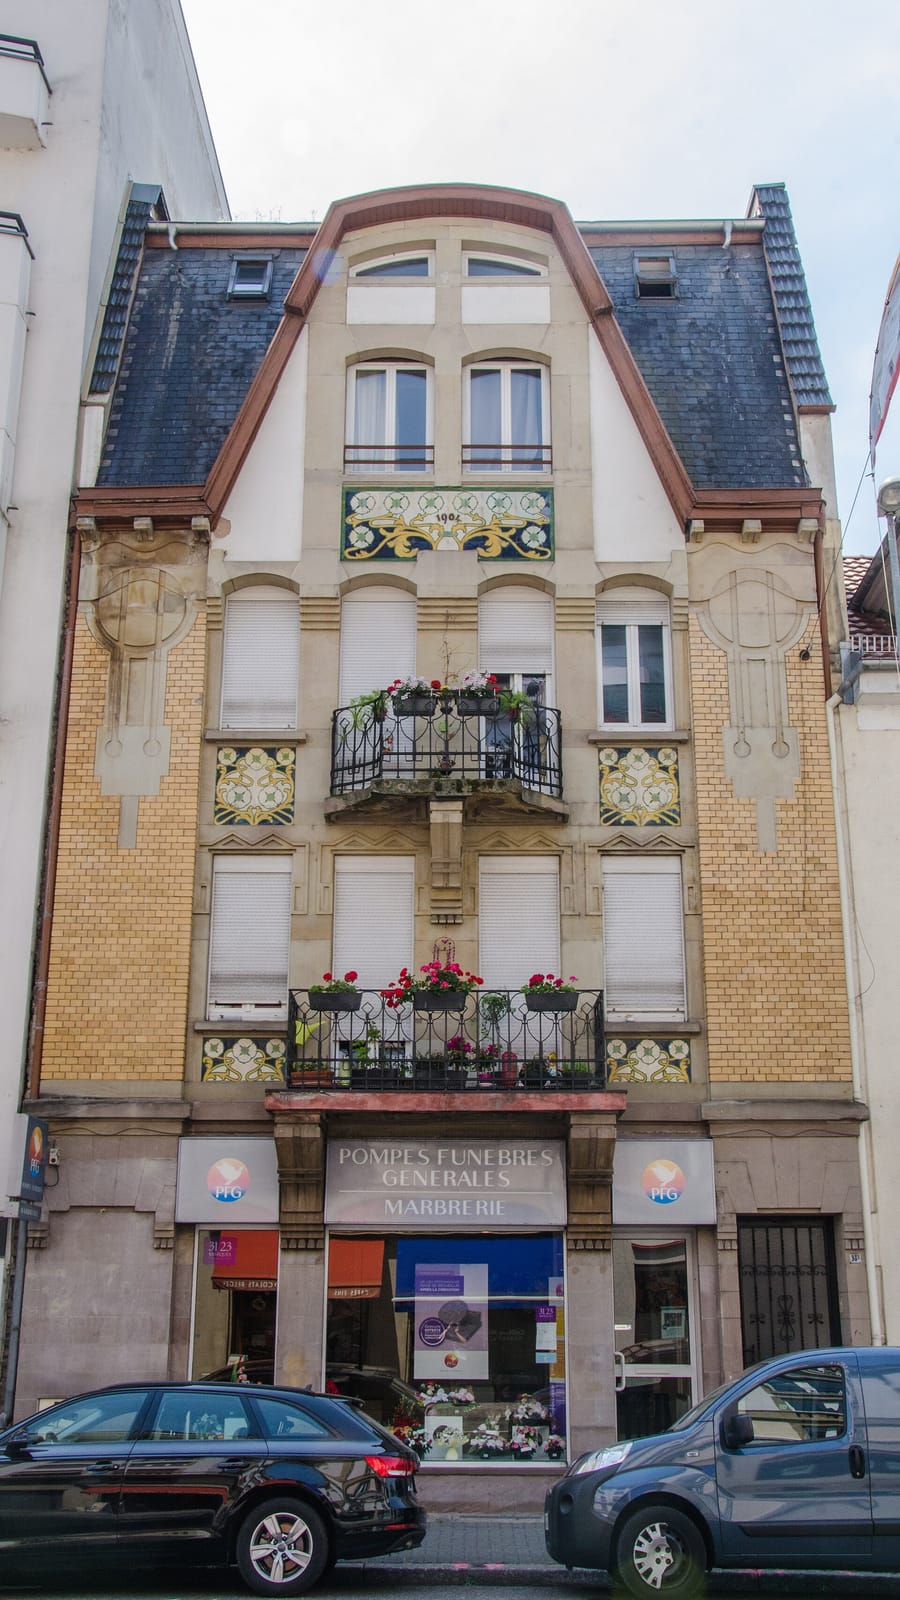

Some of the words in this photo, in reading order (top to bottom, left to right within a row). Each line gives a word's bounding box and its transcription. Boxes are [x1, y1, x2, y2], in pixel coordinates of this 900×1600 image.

[436, 513, 462, 524] 1904
[339, 1148, 430, 1166] POMPES
[437, 1149, 553, 1166] FUNEBRES
[383, 1169, 511, 1188] GENERALES
[215, 1185, 243, 1199] PFG
[650, 1186, 678, 1201] PFG
[384, 1199, 505, 1216] MARBRERIE
